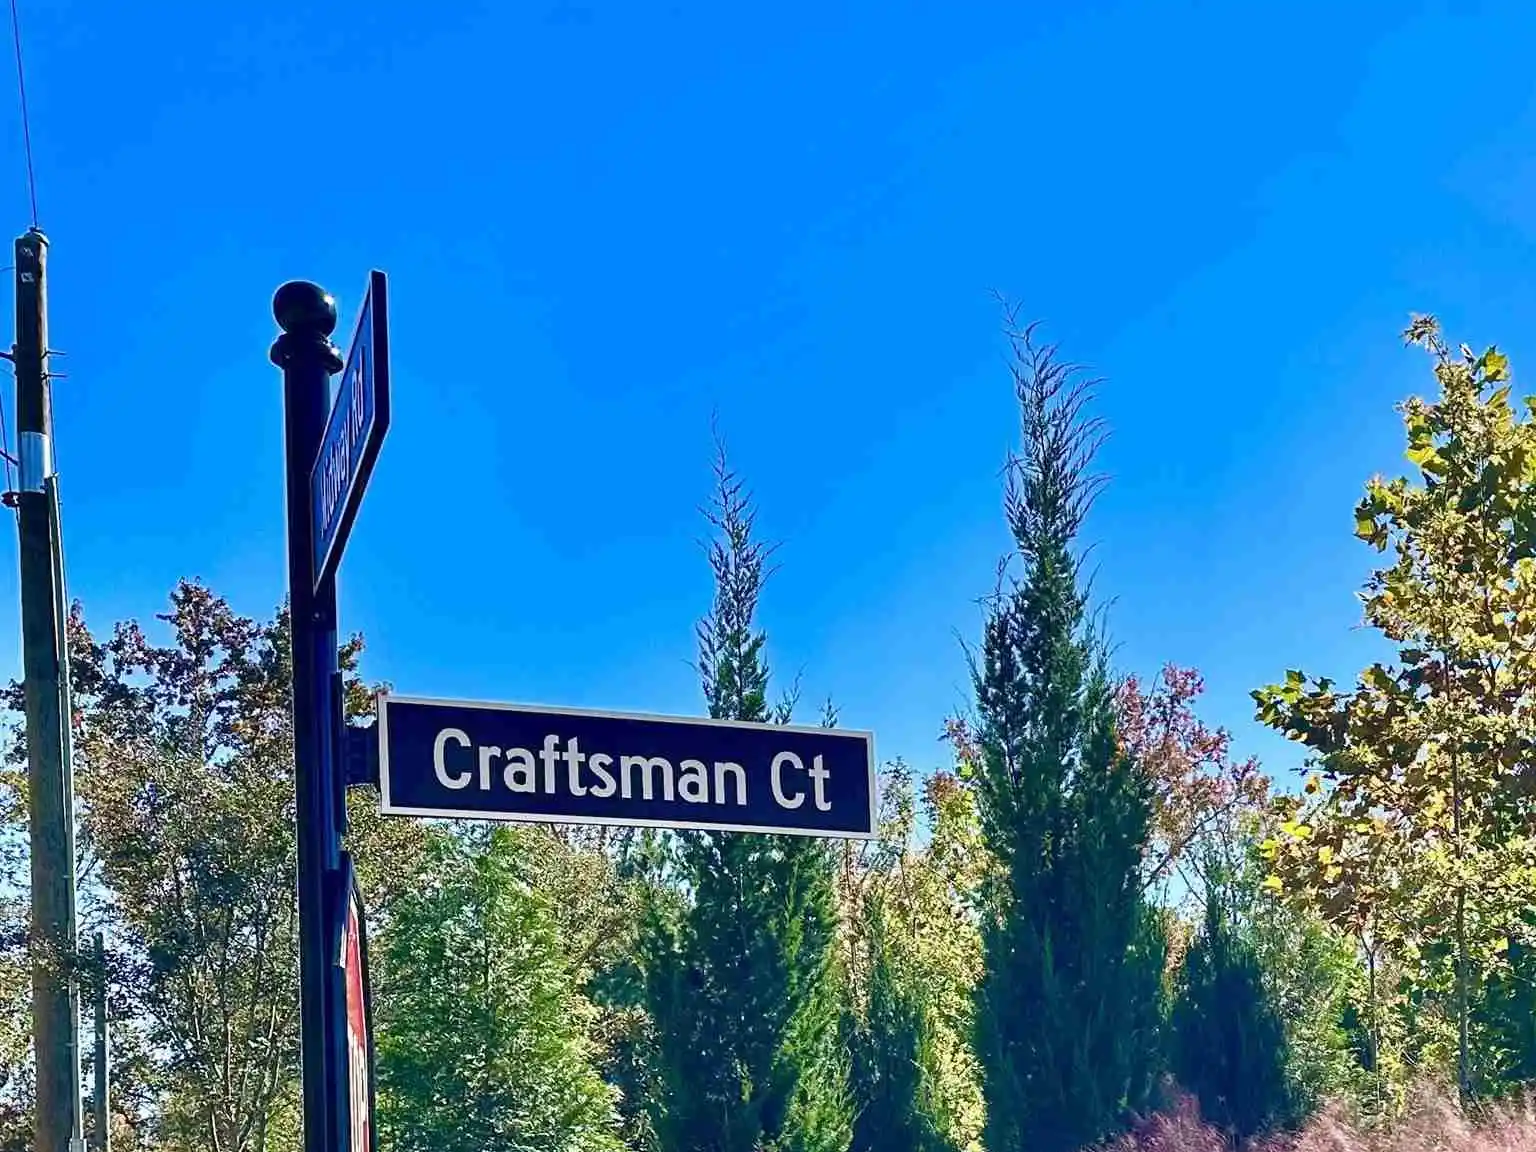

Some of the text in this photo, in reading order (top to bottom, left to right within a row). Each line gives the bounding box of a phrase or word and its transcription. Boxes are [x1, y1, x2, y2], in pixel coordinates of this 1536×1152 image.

[320, 347, 365, 539] Midway Rd
[433, 728, 832, 811] Craftsman Ct
